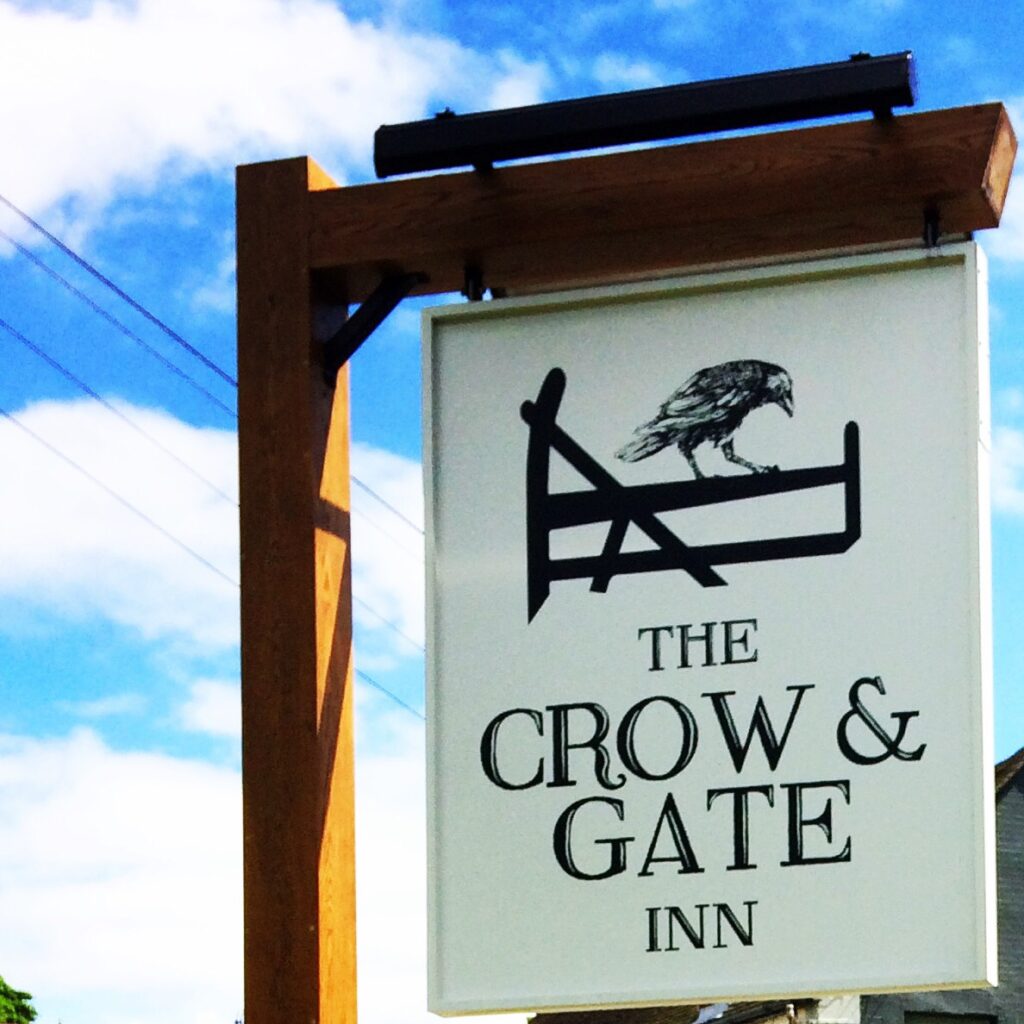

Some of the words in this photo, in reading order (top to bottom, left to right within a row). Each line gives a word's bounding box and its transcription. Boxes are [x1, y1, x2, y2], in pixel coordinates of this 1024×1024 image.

[637, 618, 758, 671] THE
[480, 684, 815, 790] CROW
[836, 676, 927, 765] &
[552, 779, 852, 881] GATE
[645, 901, 758, 952] INN
